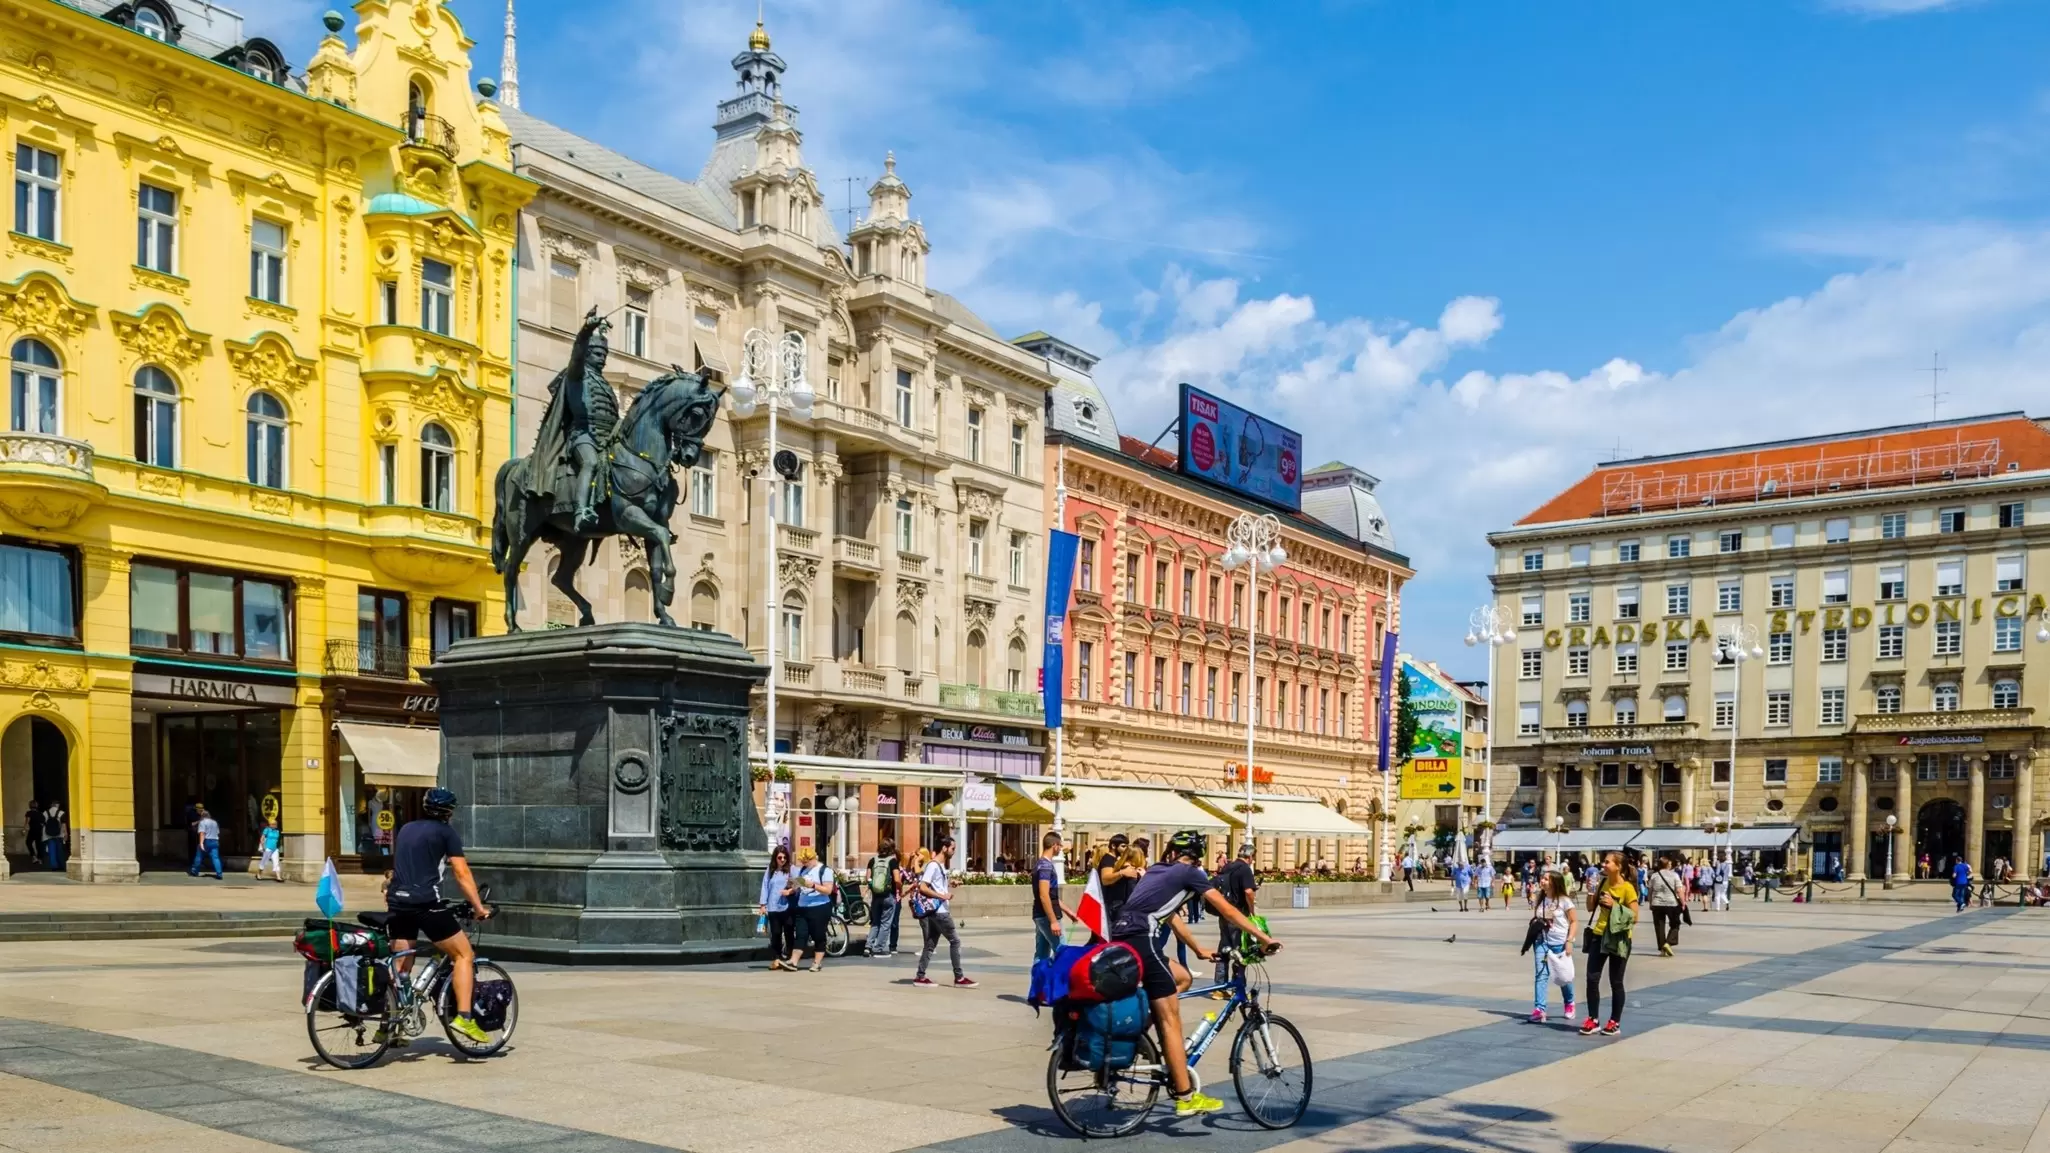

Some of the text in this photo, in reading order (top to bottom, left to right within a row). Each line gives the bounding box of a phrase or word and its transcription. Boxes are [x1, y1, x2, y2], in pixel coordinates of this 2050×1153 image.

[1191, 396, 1217, 419] TISAK
[1544, 618, 1712, 648] GRADSKA
[170, 678, 257, 701] HARMICA
[941, 725, 1029, 746] BEČKA Aida KAVANA
[1580, 747, 1614, 756] Johann
[1416, 760, 1446, 771] BILLA
[877, 793, 896, 805] Aida
